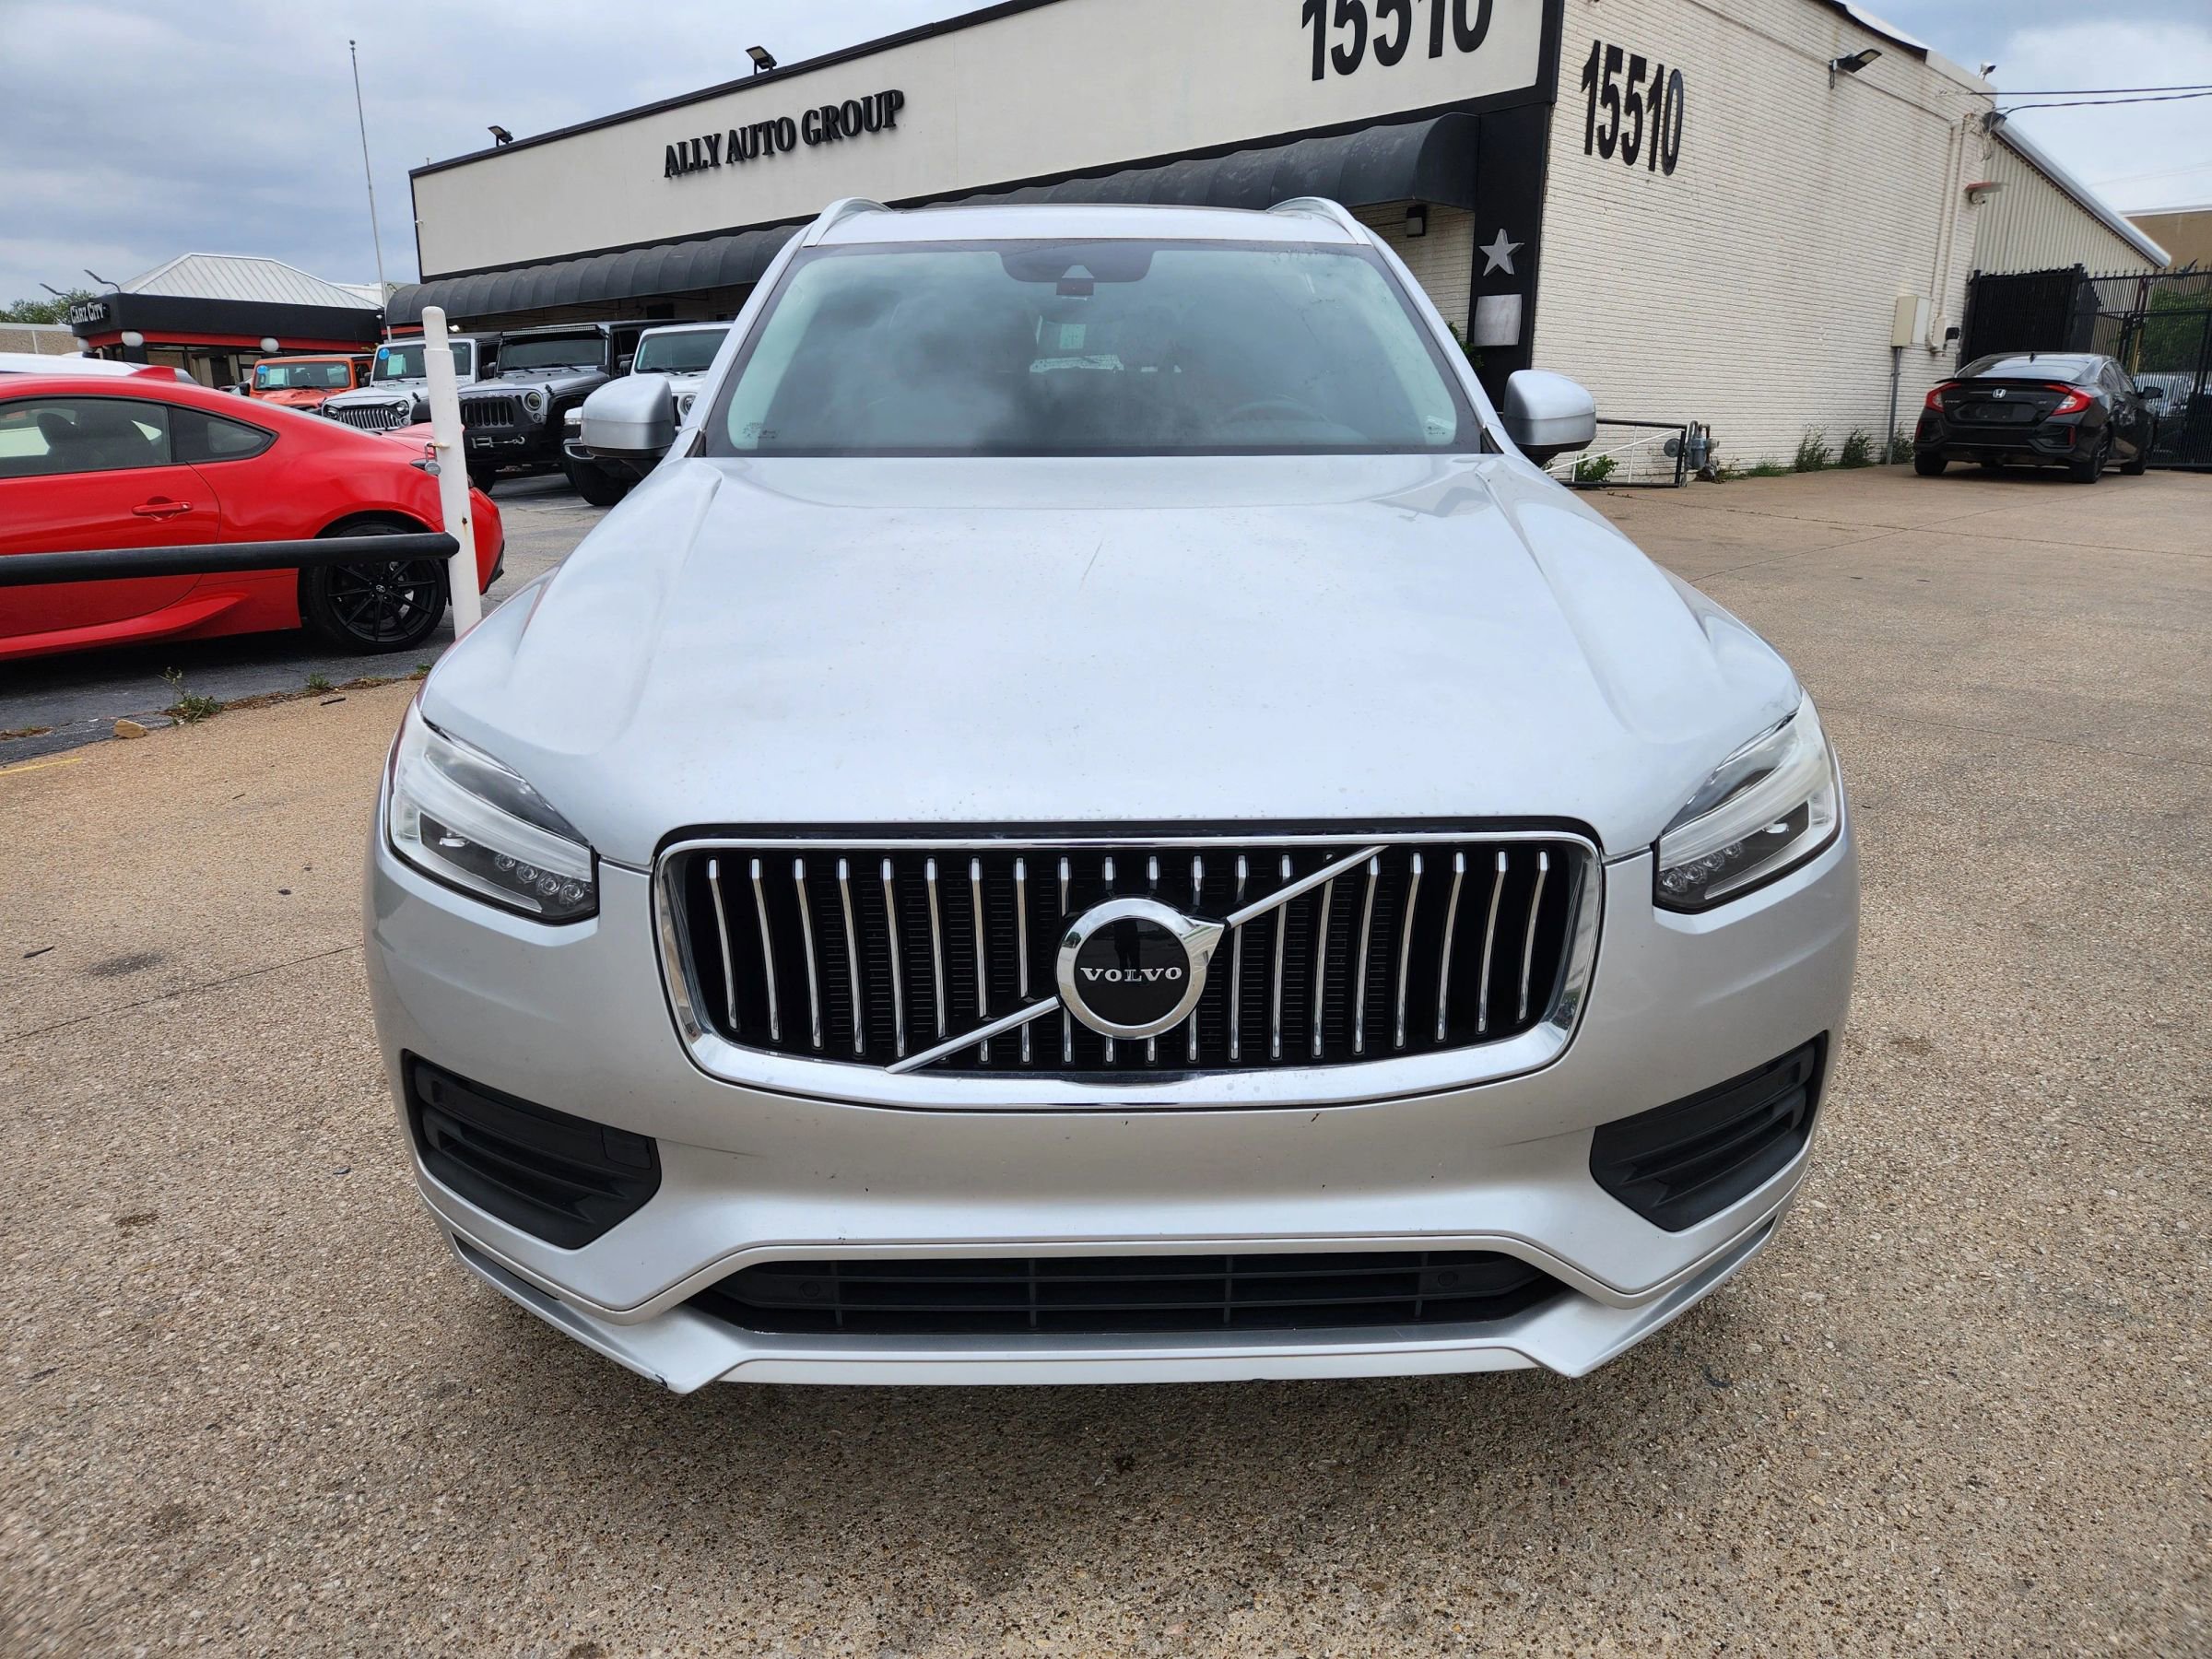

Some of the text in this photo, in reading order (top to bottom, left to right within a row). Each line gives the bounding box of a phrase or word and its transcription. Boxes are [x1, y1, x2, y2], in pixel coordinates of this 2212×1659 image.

[664, 88, 905, 178] ALLY AUTO GROUP
[1581, 40, 1684, 176] 15510
[70, 301, 104, 324] CARZ CITY
[1080, 967, 1182, 982] VOLVO
